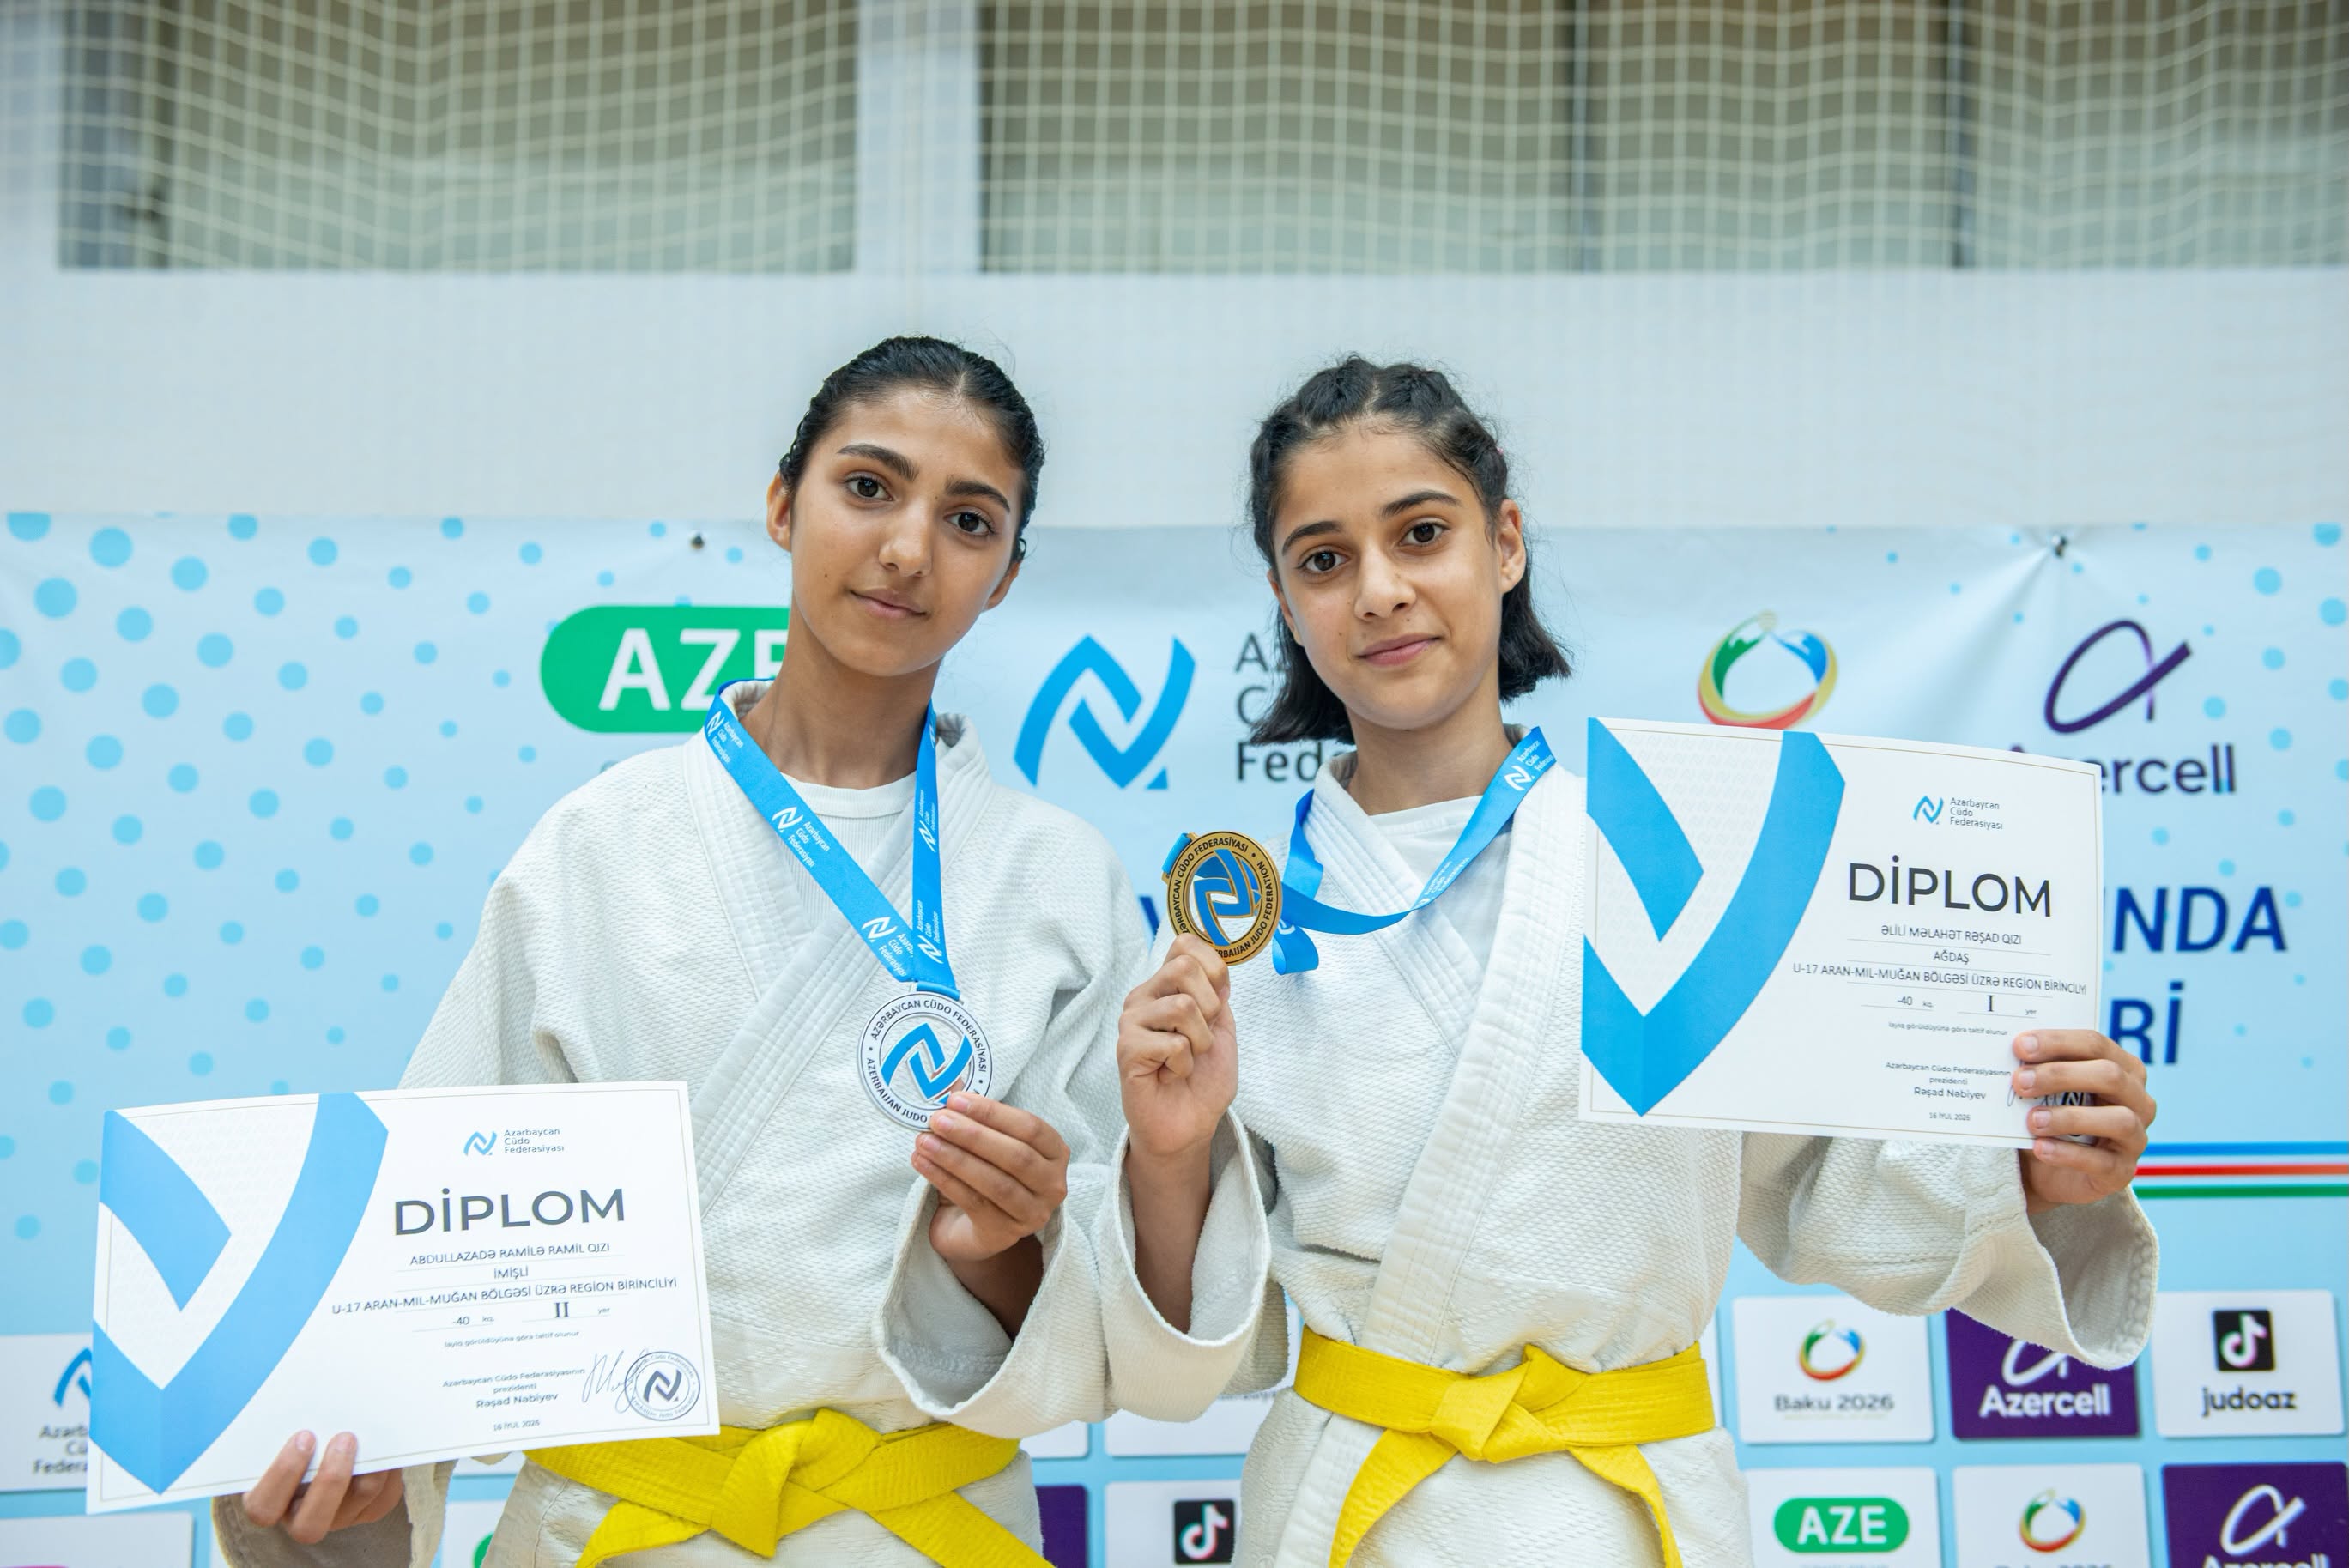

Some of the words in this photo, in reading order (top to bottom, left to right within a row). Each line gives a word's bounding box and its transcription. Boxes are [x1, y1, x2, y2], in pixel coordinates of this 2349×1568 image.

[796, 827, 809, 844] Cüdo
[1950, 817, 2003, 831] Federasiyası
[1194, 836, 1249, 856] FEDERASİYASI
[1177, 852, 1195, 879] CÜDO
[1256, 860, 1274, 921] FEDERATION
[1849, 855, 2050, 917] DİPLOM
[1172, 879, 1190, 934] ƏRBAYCAN
[2102, 886, 2288, 953] NDA
[1251, 921, 1268, 946] JUDO
[1910, 927, 1963, 941] MƏLAHƏT
[1965, 931, 2000, 944] RƏŞAD
[2001, 934, 2022, 945] QIZI
[888, 939, 903, 955] Cüdo
[1933, 950, 1970, 965] AĞDAŞ
[1793, 963, 1819, 974] U-17
[1923, 971, 1969, 985] BÖLGƏSİ
[1971, 973, 2001, 987] ÜZRƏ
[1898, 996, 1913, 1007] -40
[1988, 995, 1994, 1012] I
[870, 1000, 922, 1041] AZƏRBAYCAN
[923, 998, 952, 1015] CÜDO
[952, 1011, 987, 1073] FEDERASİYASI
[866, 1057, 901, 1112] AZERBAIJAN
[902, 1108, 928, 1123] JUDO
[1914, 1087, 1944, 1098] Rəşad
[504, 1144, 565, 1154] Federasiyası
[395, 1188, 625, 1235] DİPLOM
[409, 1250, 496, 1266] ABDULLAZADƏ
[499, 1246, 545, 1259] RAMİLƏ
[587, 1243, 610, 1253] QIZI
[493, 1265, 529, 1280] İMİŞLİ
[332, 1302, 361, 1315] U-17
[481, 1285, 531, 1299] BÖLGƏSİ
[535, 1283, 566, 1297] ÜZRƏ
[570, 1280, 614, 1293] REGİON
[452, 1317, 470, 1326] -40
[554, 1302, 569, 1318] II
[493, 1383, 536, 1395] prezidenti
[1978, 1383, 2113, 1417] Azercell
[475, 1396, 511, 1408] Rəşad
[1774, 1394, 1831, 1412] Baku
[1837, 1394, 1895, 1412] 2026
[2200, 1387, 2298, 1418] judoaz
[1797, 1505, 1888, 1545] AZE
